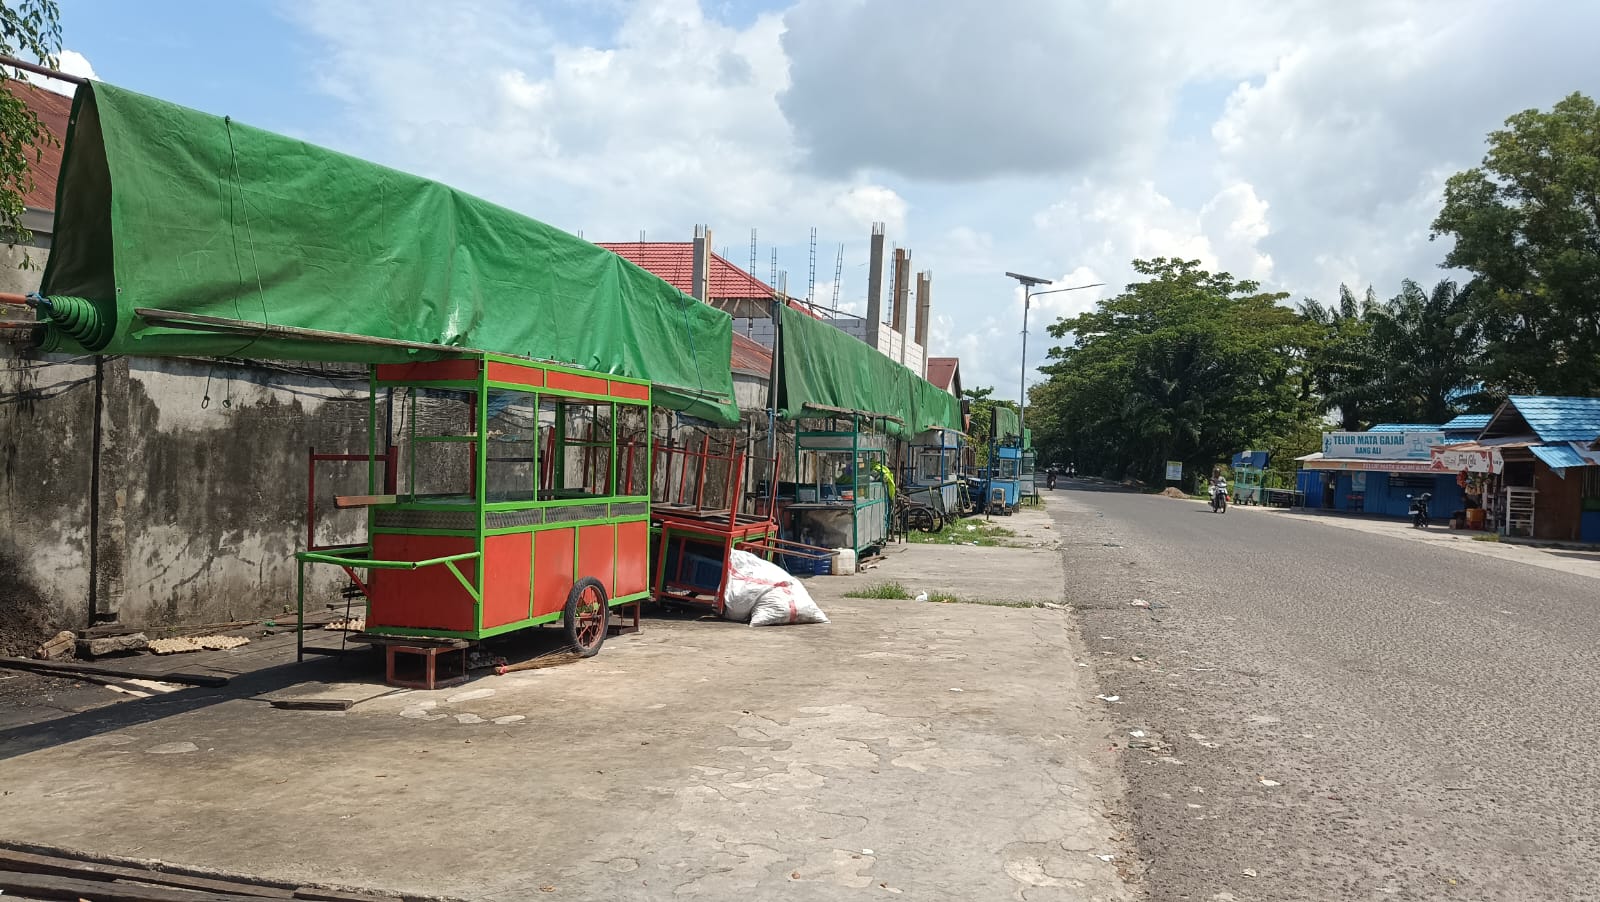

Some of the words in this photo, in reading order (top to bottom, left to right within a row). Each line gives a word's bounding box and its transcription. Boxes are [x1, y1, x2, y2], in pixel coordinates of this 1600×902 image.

[1333, 436, 1356, 445] TELUR
[1357, 435, 1378, 445] MATA
[1380, 435, 1404, 445] GAJAH
[1372, 446, 1381, 454] ALI
